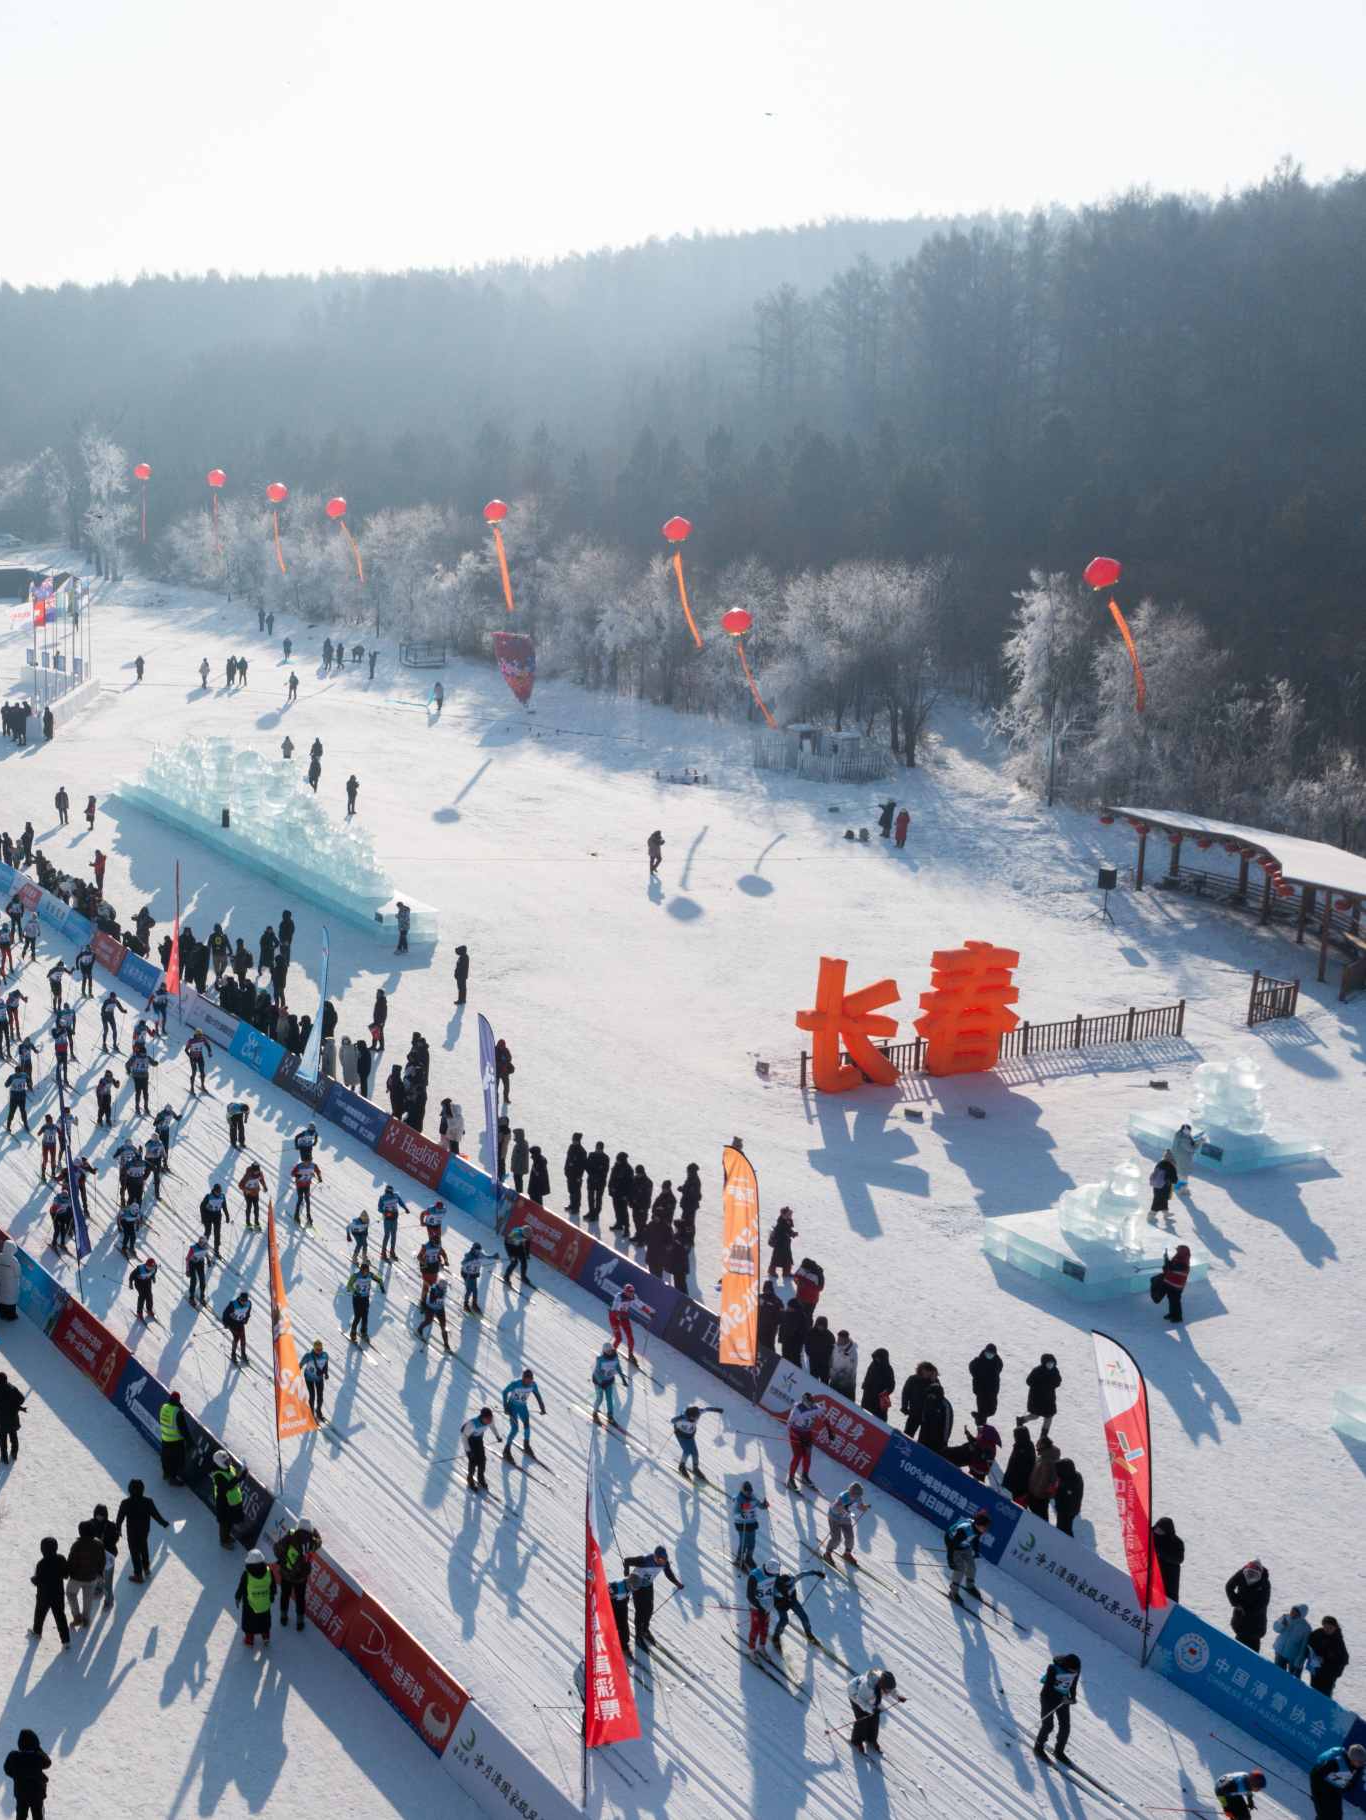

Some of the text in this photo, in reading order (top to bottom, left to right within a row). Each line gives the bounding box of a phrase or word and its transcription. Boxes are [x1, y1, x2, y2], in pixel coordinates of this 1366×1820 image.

[794, 940, 1021, 1093] 长春
[309, 1561, 340, 1603] 民健身
[1215, 1657, 1327, 1738] 中国滑雪协会
